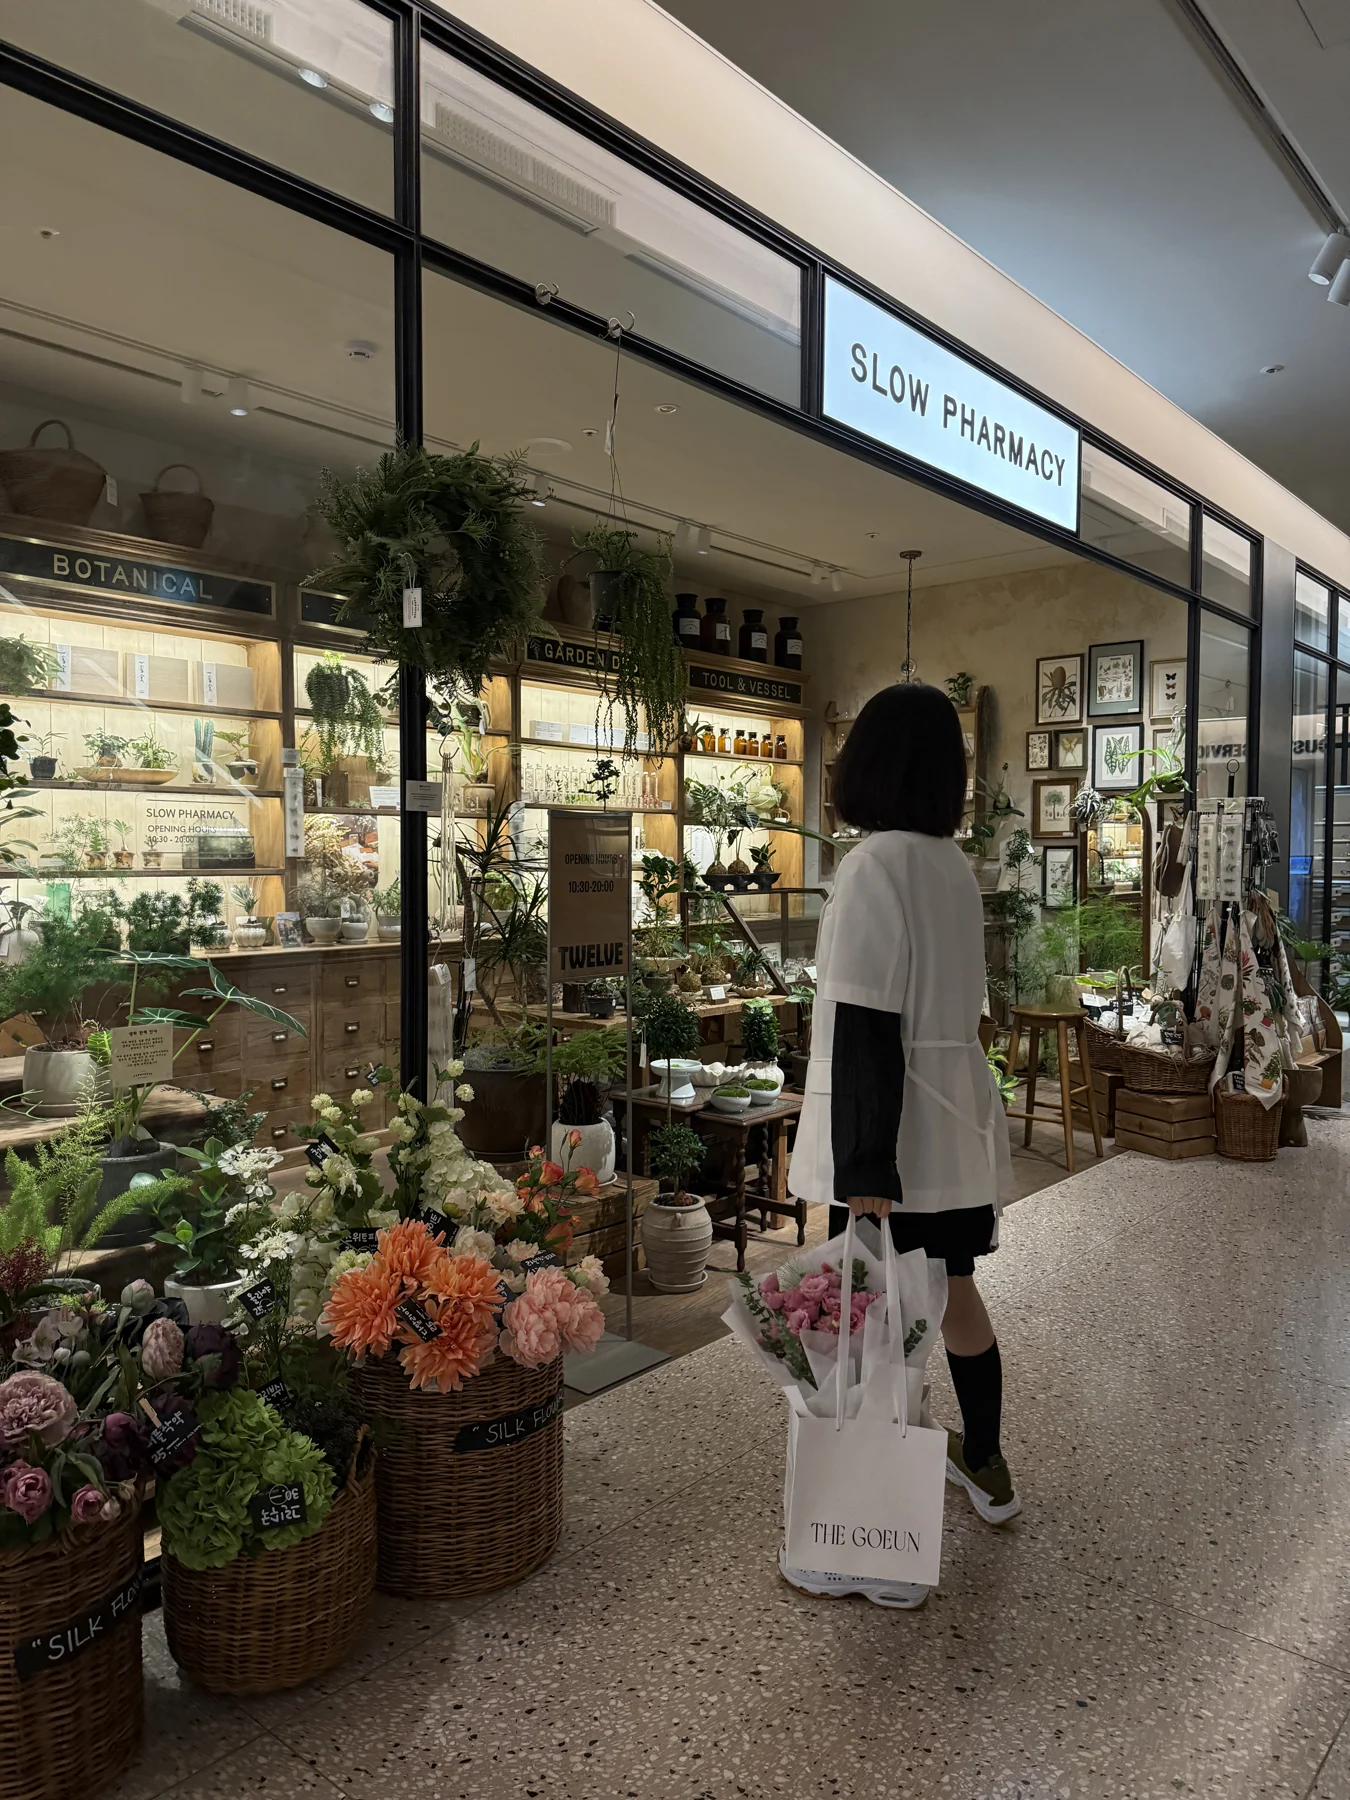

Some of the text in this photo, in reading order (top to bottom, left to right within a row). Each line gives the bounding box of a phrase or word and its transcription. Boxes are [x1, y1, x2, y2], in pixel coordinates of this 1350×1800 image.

[850, 342, 1066, 488] SLOW PHARMACY
[53, 553, 213, 600] BOTANICAL
[544, 643, 605, 668] GARDEN
[702, 672, 791, 699] TOOL & VESSEL
[146, 808, 235, 820] SLOW PHARMACY
[147, 824, 186, 834] OPENING
[565, 854, 595, 865] OPENING
[568, 880, 614, 893] 10:30-20:00
[557, 942, 624, 971] TWELVE
[811, 1522, 921, 1553] THE GOEUN
